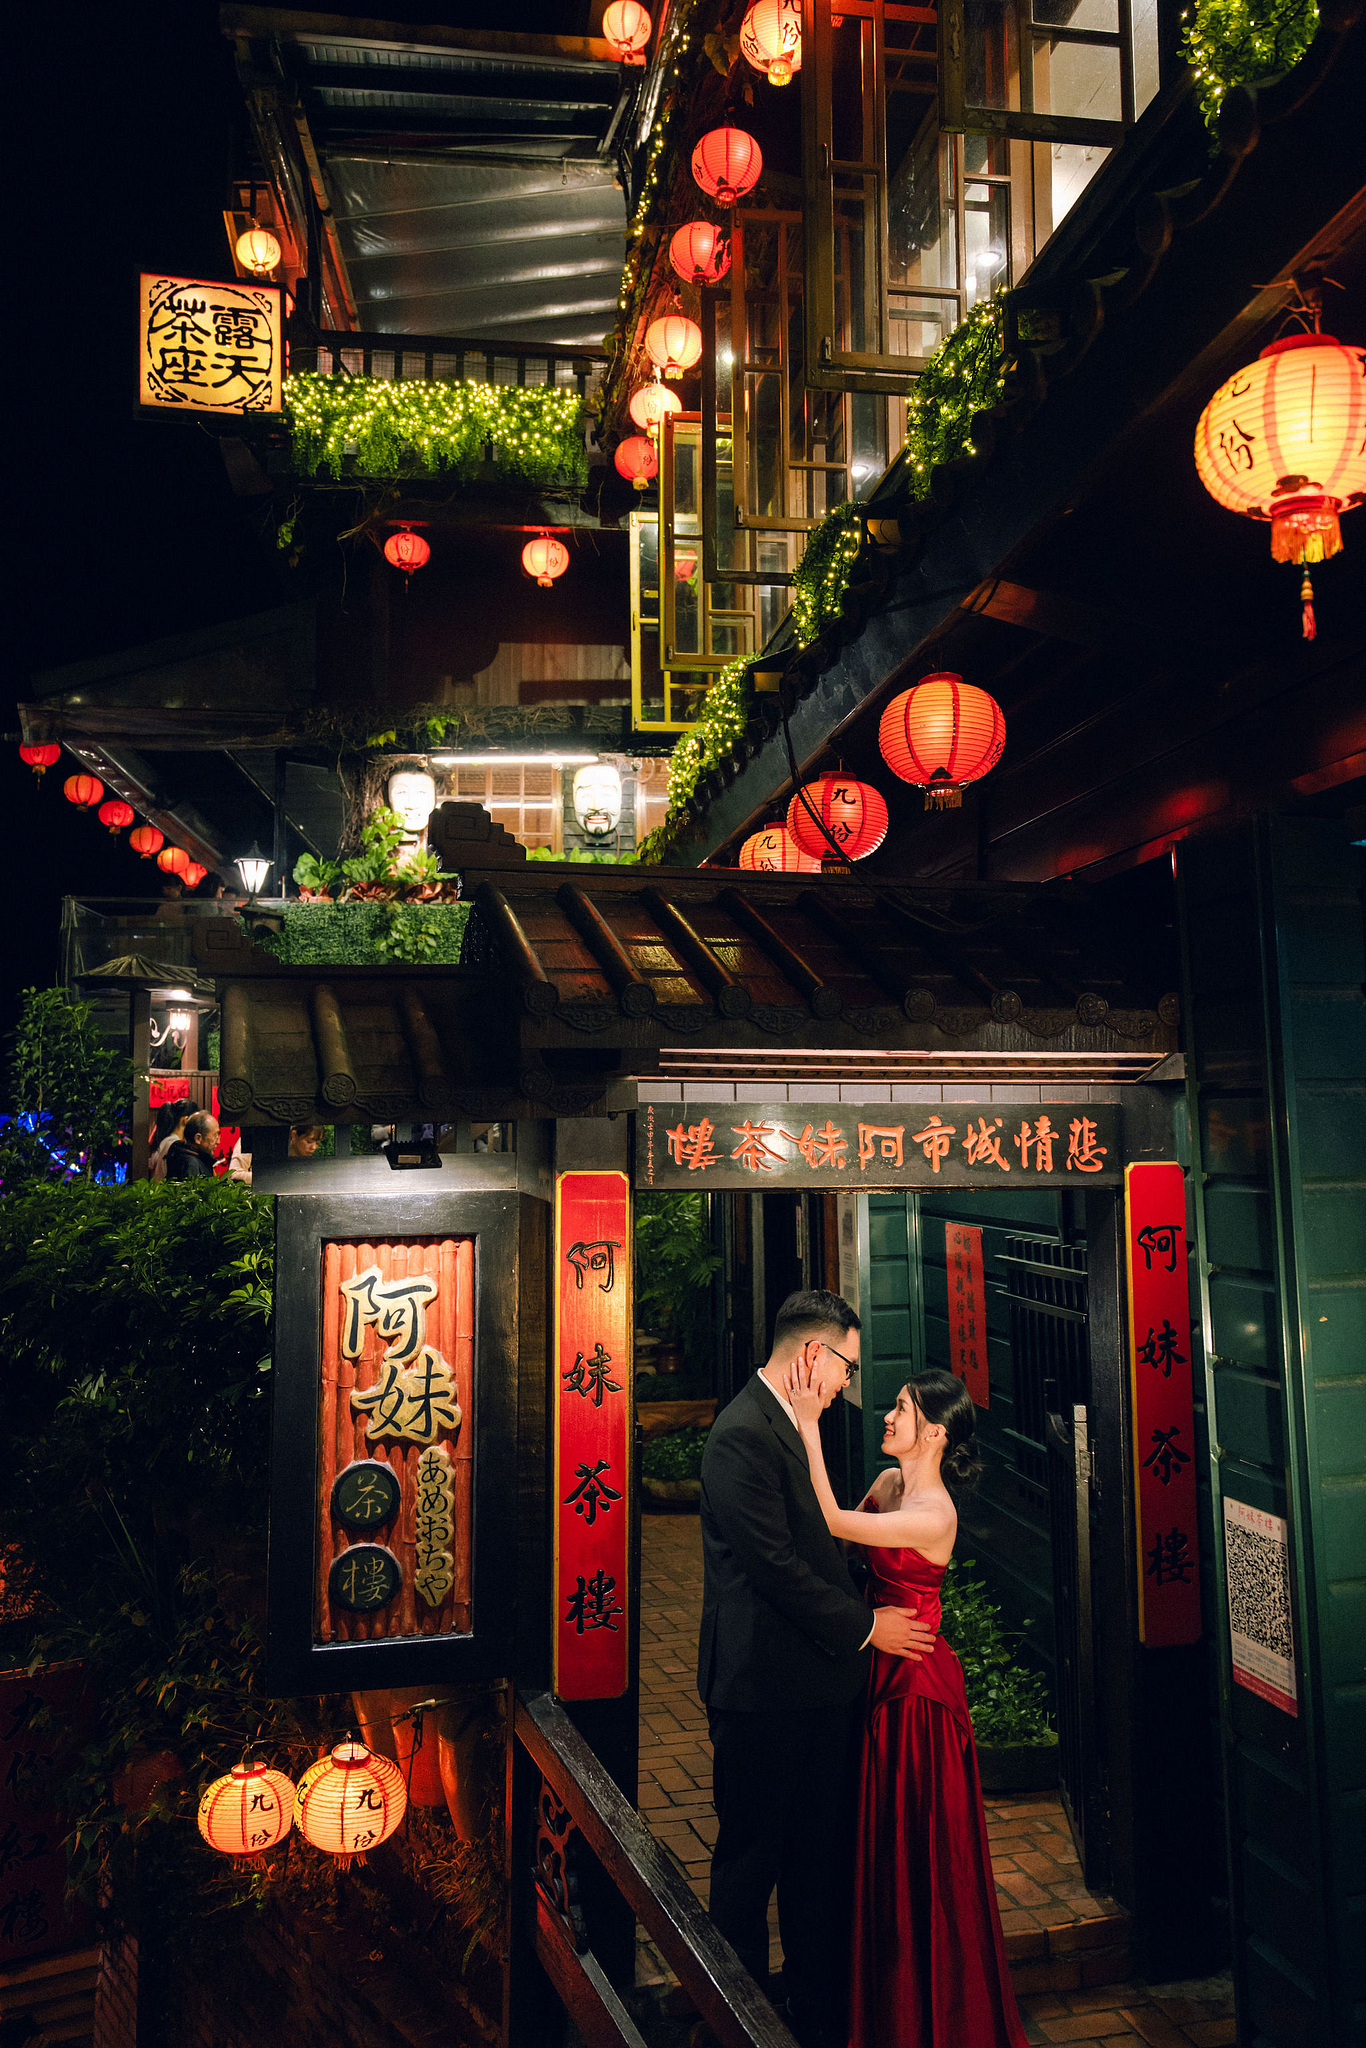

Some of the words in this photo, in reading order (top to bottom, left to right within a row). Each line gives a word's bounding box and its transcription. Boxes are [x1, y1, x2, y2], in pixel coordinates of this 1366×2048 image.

[830, 788, 855, 843] 九份
[1136, 1224, 1196, 1588] 阿妹茶樓
[562, 1242, 623, 1635] 阿妹茶樓
[249, 1794, 273, 1847] 九份
[354, 1788, 382, 1849] 九份
